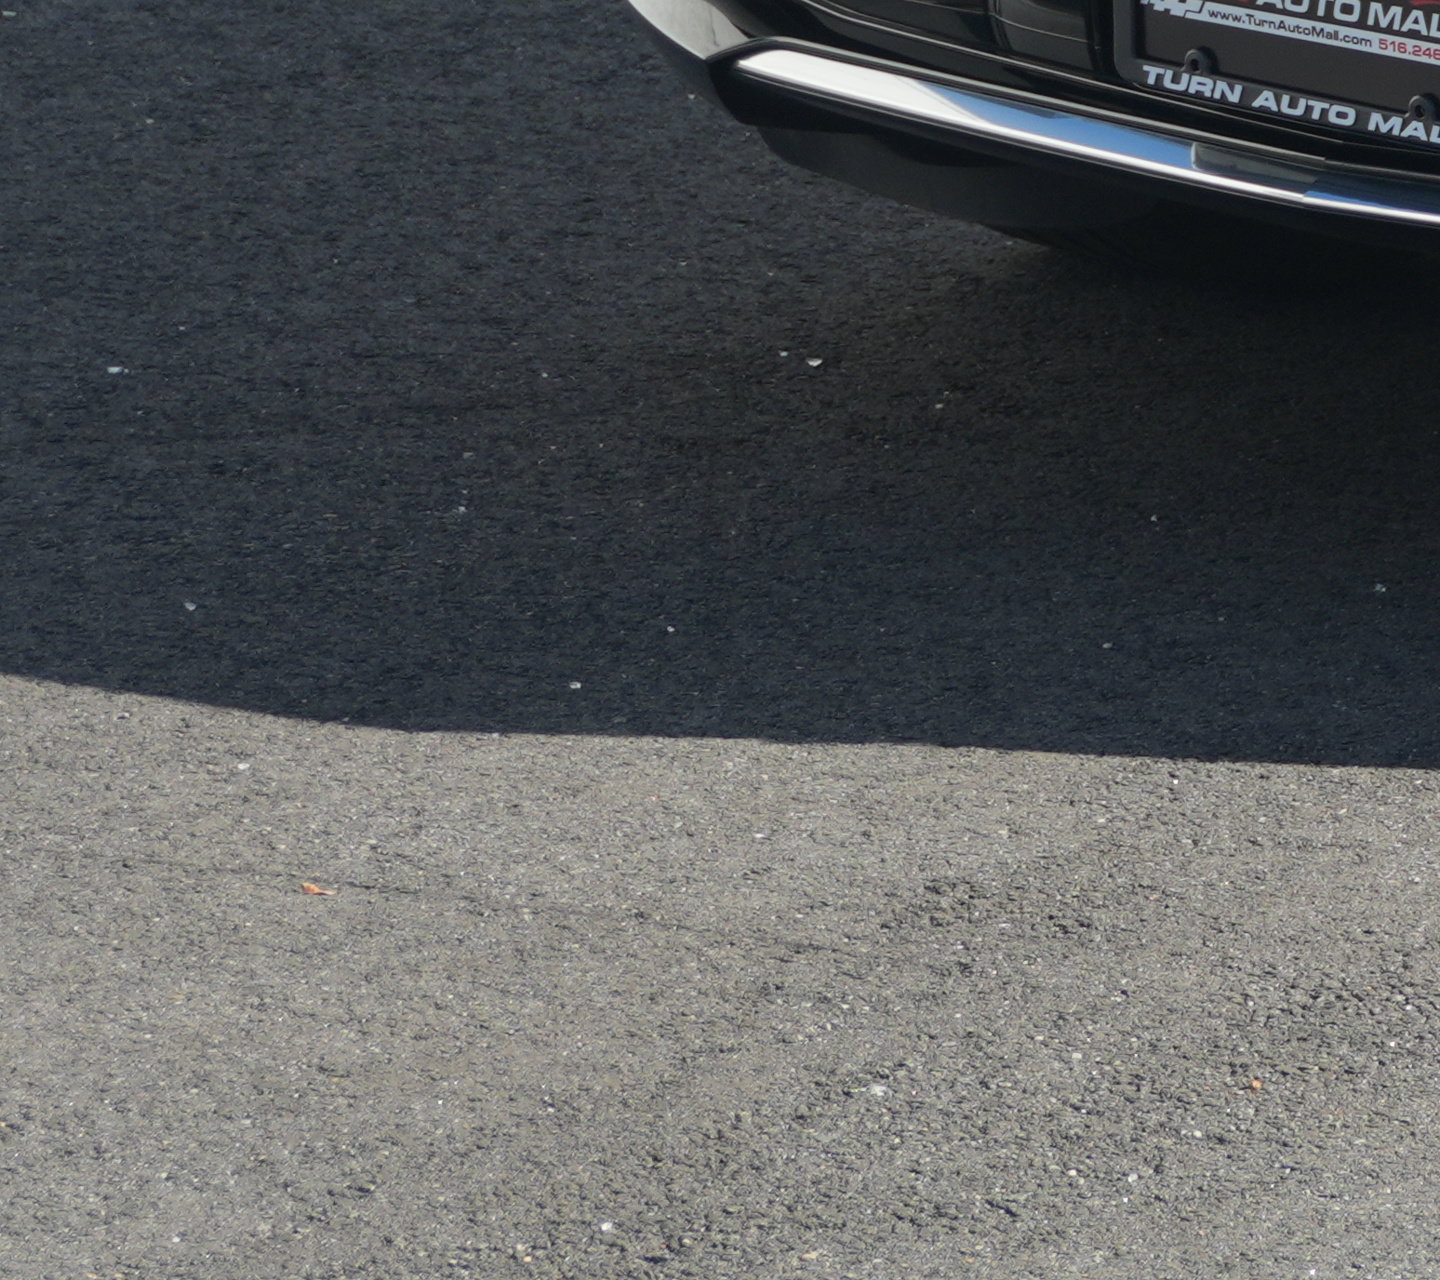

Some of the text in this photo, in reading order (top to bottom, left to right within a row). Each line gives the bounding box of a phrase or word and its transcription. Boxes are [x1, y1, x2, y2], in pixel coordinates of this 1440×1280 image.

[1207, 8, 1373, 49] www.TurnAutoMall.com
[1142, 64, 1242, 104] TURN
[1251, 90, 1357, 127] AUTO
